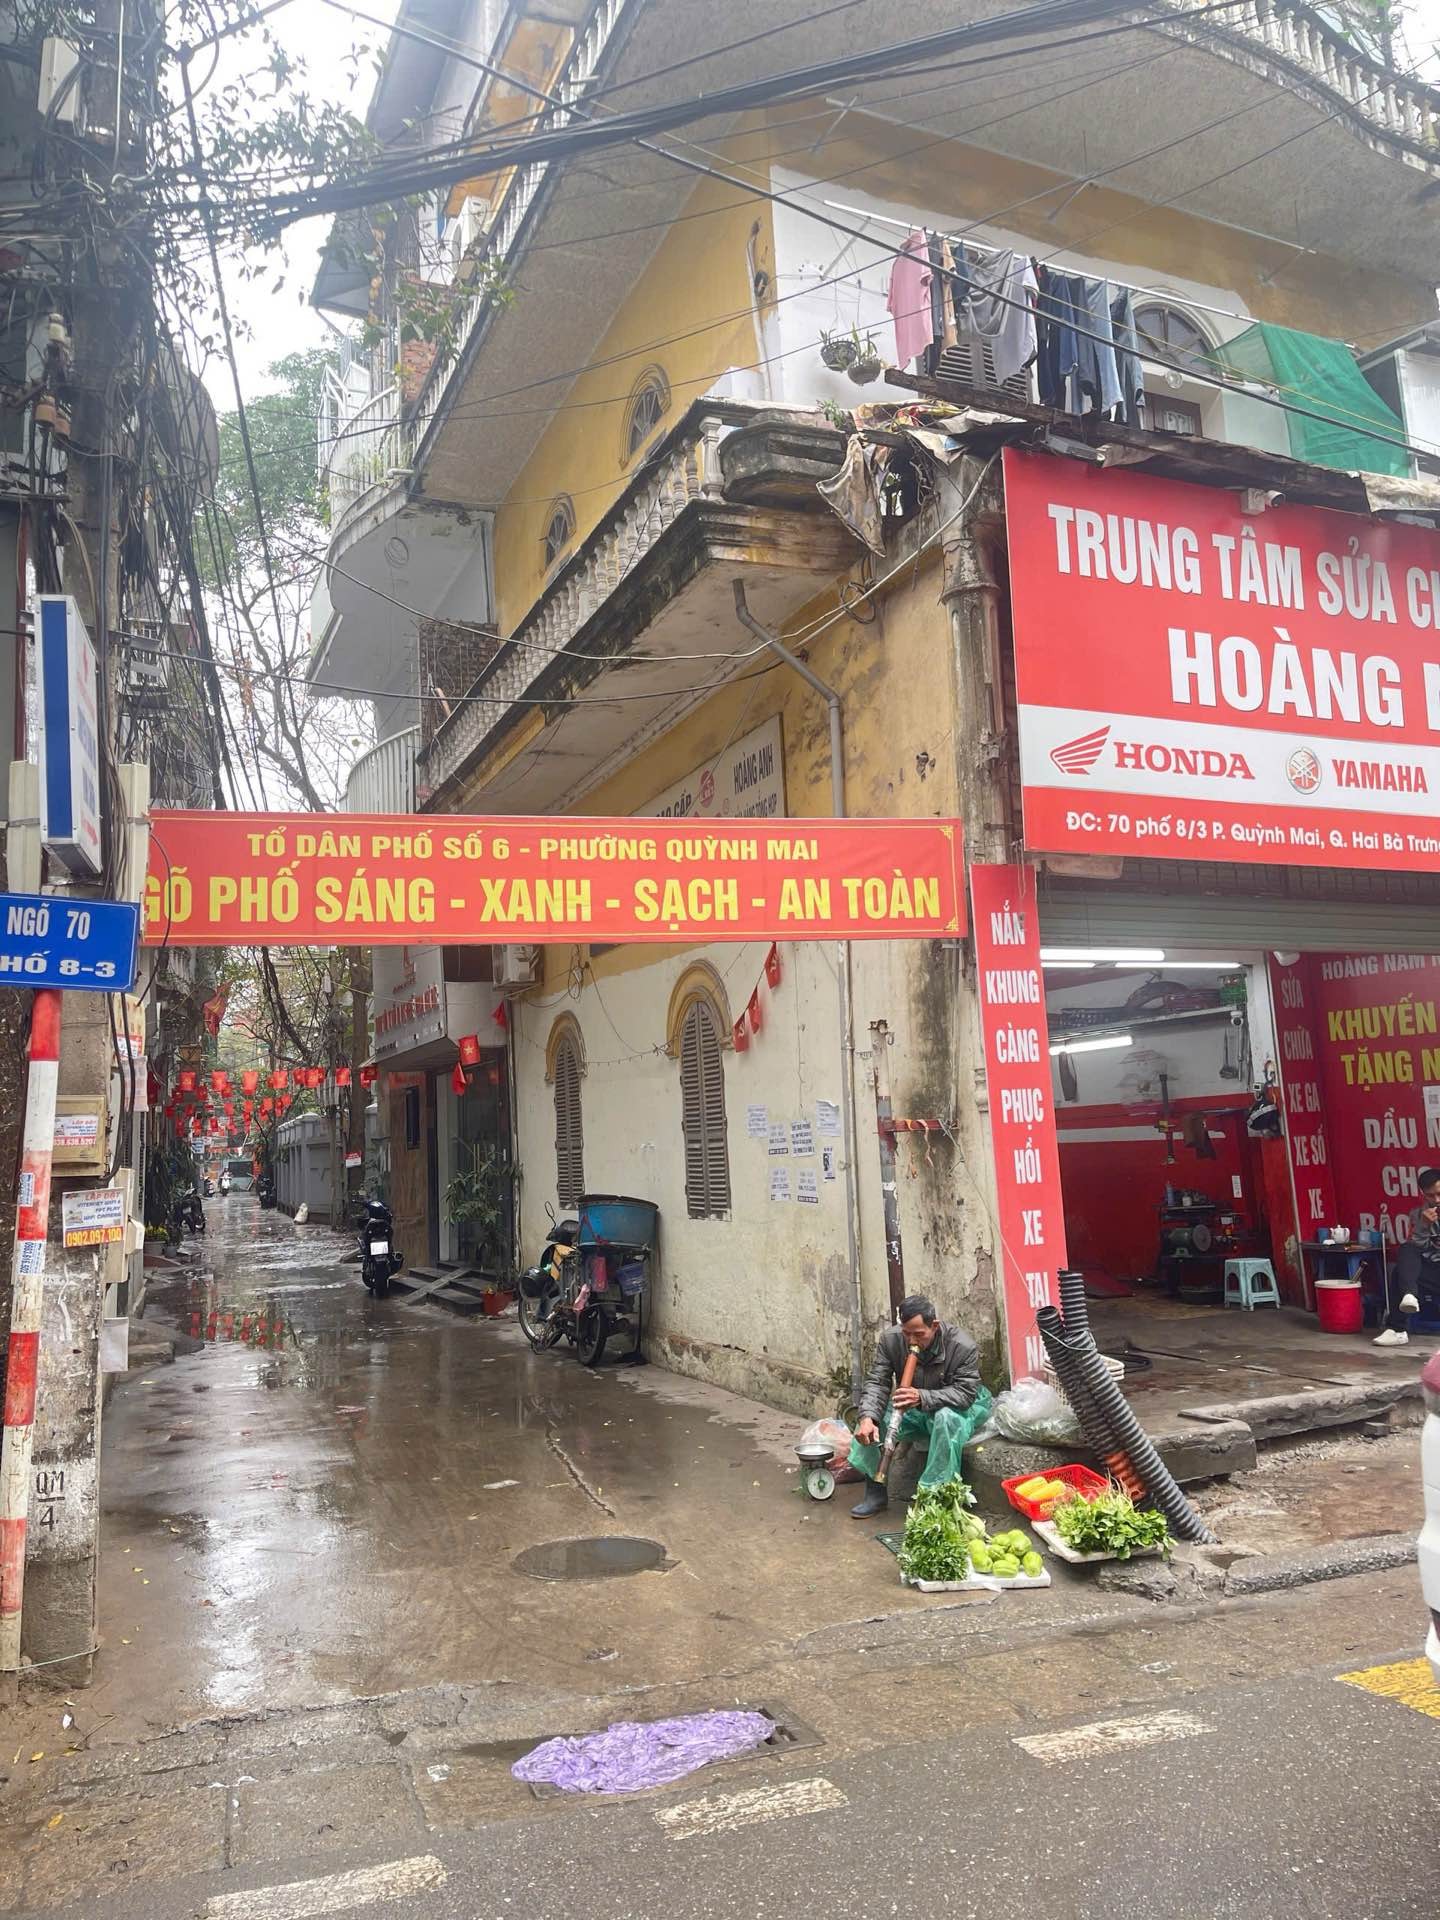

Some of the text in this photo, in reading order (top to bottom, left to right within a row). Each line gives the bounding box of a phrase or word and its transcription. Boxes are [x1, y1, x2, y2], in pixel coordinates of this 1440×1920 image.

[1048, 503, 1201, 595] TRUNG
[1212, 525, 1304, 611] TÂM
[1316, 536, 1398, 624] SỬA
[1167, 625, 1405, 728] HOÀNG
[1113, 741, 1429, 794] HONDA YAMAHA
[247, 826, 286, 858] TỔ
[296, 831, 361, 859] DÂN
[372, 829, 433, 860] PHỐ
[443, 830, 483, 860] SỐ
[492, 838, 510, 860] 6
[540, 834, 657, 861] PHƯỜNG
[666, 835, 758, 862] QUỲNH
[767, 839, 819, 861] MAI
[1066, 812, 1440, 853] ĐC: 70 phố 8/3 P. Quỳnh Mai, Q. Hai Bà Trưn
[209, 861, 301, 923] PHỐ
[315, 868, 436, 924] SÁNG
[450, 898, 465, 909] -
[480, 878, 592, 923] XANH
[606, 898, 620, 909] -
[634, 878, 739, 931] SẠCH
[752, 897, 766, 908] -
[779, 877, 832, 920] AN
[842, 869, 940, 920] TOÀN
[7, 903, 91, 940] NGÕ 70
[59, 959, 116, 978] 8-3
[985, 969, 1040, 1004] KHUNG
[1322, 955, 1379, 981] HOÀNG
[1384, 954, 1425, 973] NAM
[1328, 992, 1437, 1042] KHUYẾN
[996, 1022, 1040, 1063] CÀNG
[1340, 1047, 1414, 1092] TẶNG
[1000, 1088, 1044, 1130] PHỤC
[1288, 1082, 1320, 1113] XE GA
[1294, 1123, 1326, 1166] XE SỐ
[1363, 1107, 1418, 1149] DẦU
[1308, 1188, 1325, 1219] XE
[66, 1228, 122, 1247] 0902.097.100
[1022, 1210, 1044, 1246] XE
[40, 1506, 54, 1532] 4
